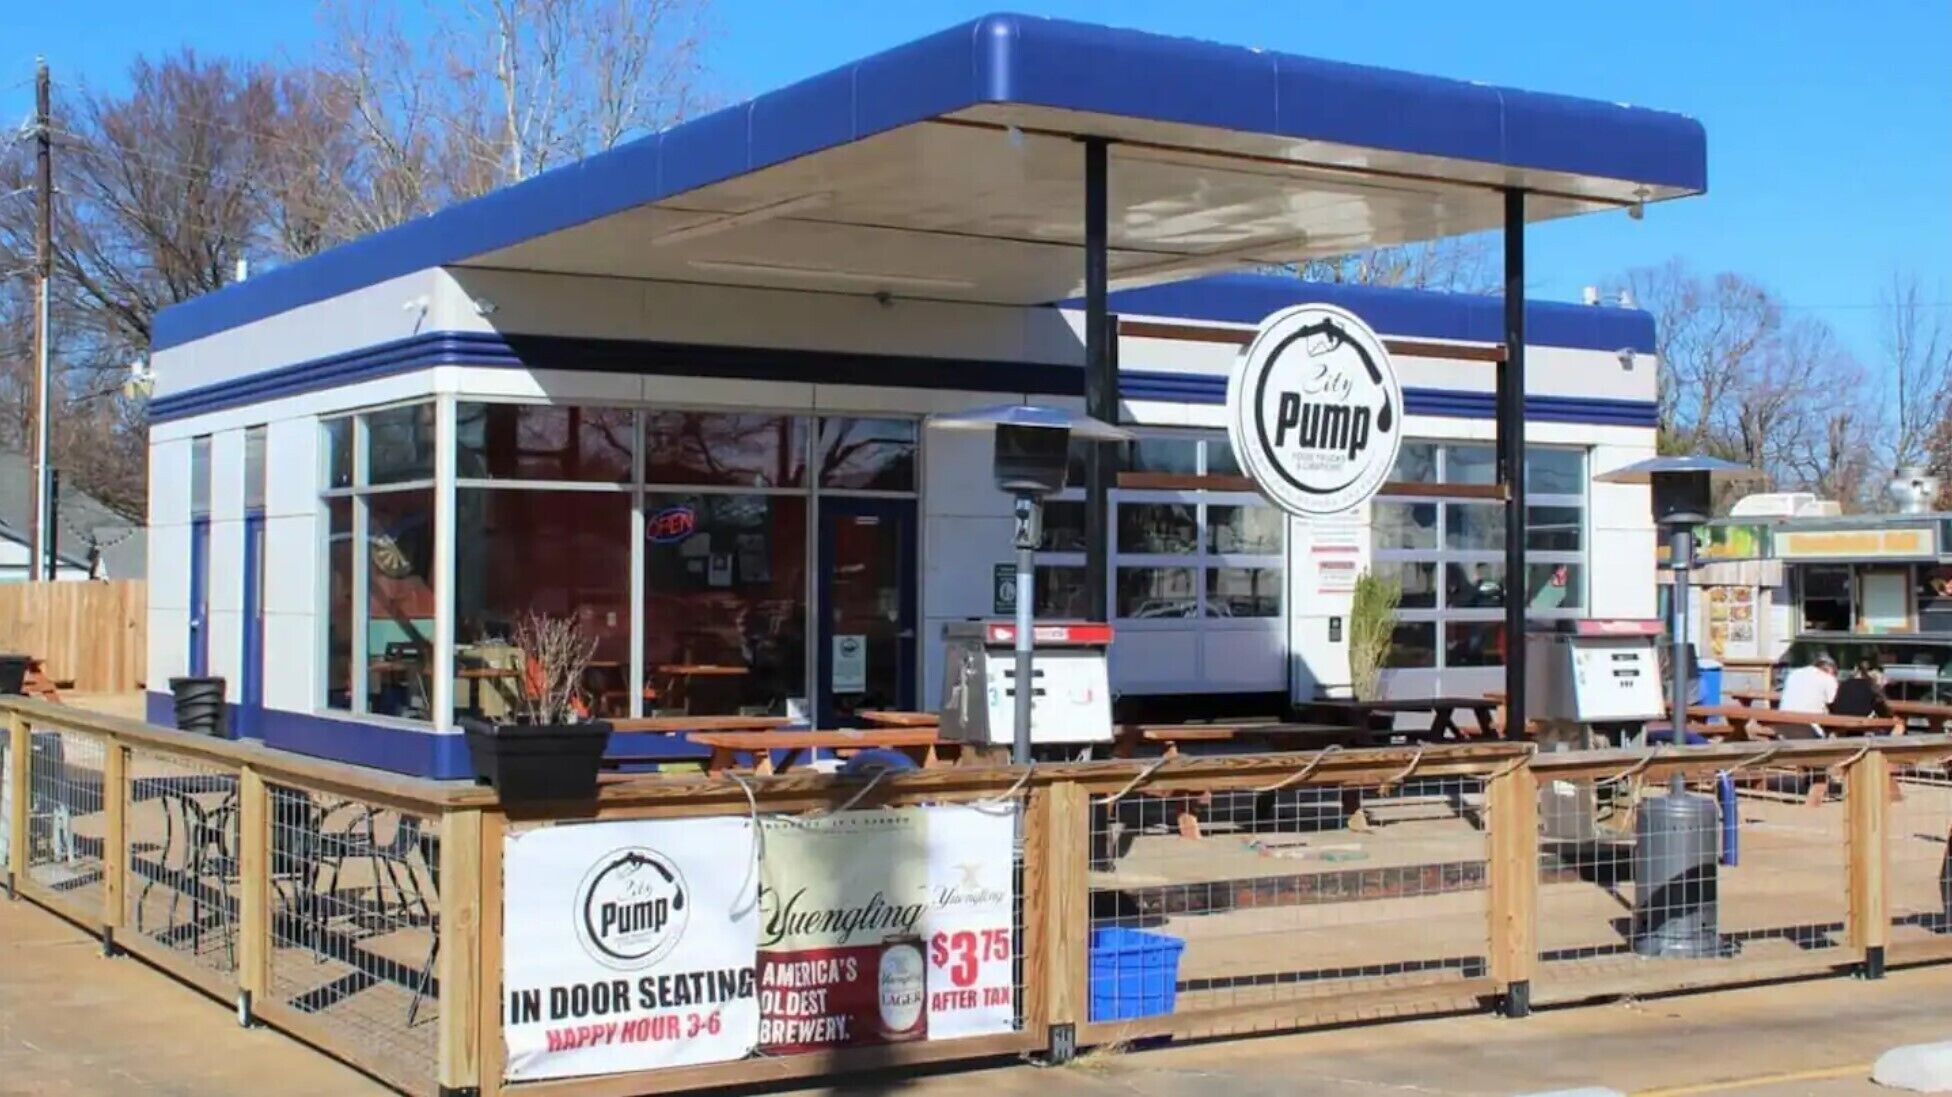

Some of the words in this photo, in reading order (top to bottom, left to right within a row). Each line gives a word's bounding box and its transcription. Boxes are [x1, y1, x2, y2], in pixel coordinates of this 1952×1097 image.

[1275, 392, 1371, 461] Pump
[649, 511, 694, 538] OPEN
[932, 885, 1005, 910] Yuengling
[601, 897, 669, 938] Pump
[757, 885, 925, 946] Yuengling
[761, 957, 858, 987] AMERICA'S
[511, 988, 540, 1025] IN
[550, 979, 632, 1018] DOOR
[638, 967, 756, 1010] SEATING
[760, 988, 827, 1017] OLDEST
[931, 991, 977, 1012] AFTER
[546, 1023, 617, 1053] HAPPY
[621, 1017, 681, 1044] HOUR
[687, 1010, 722, 1039] 3-6
